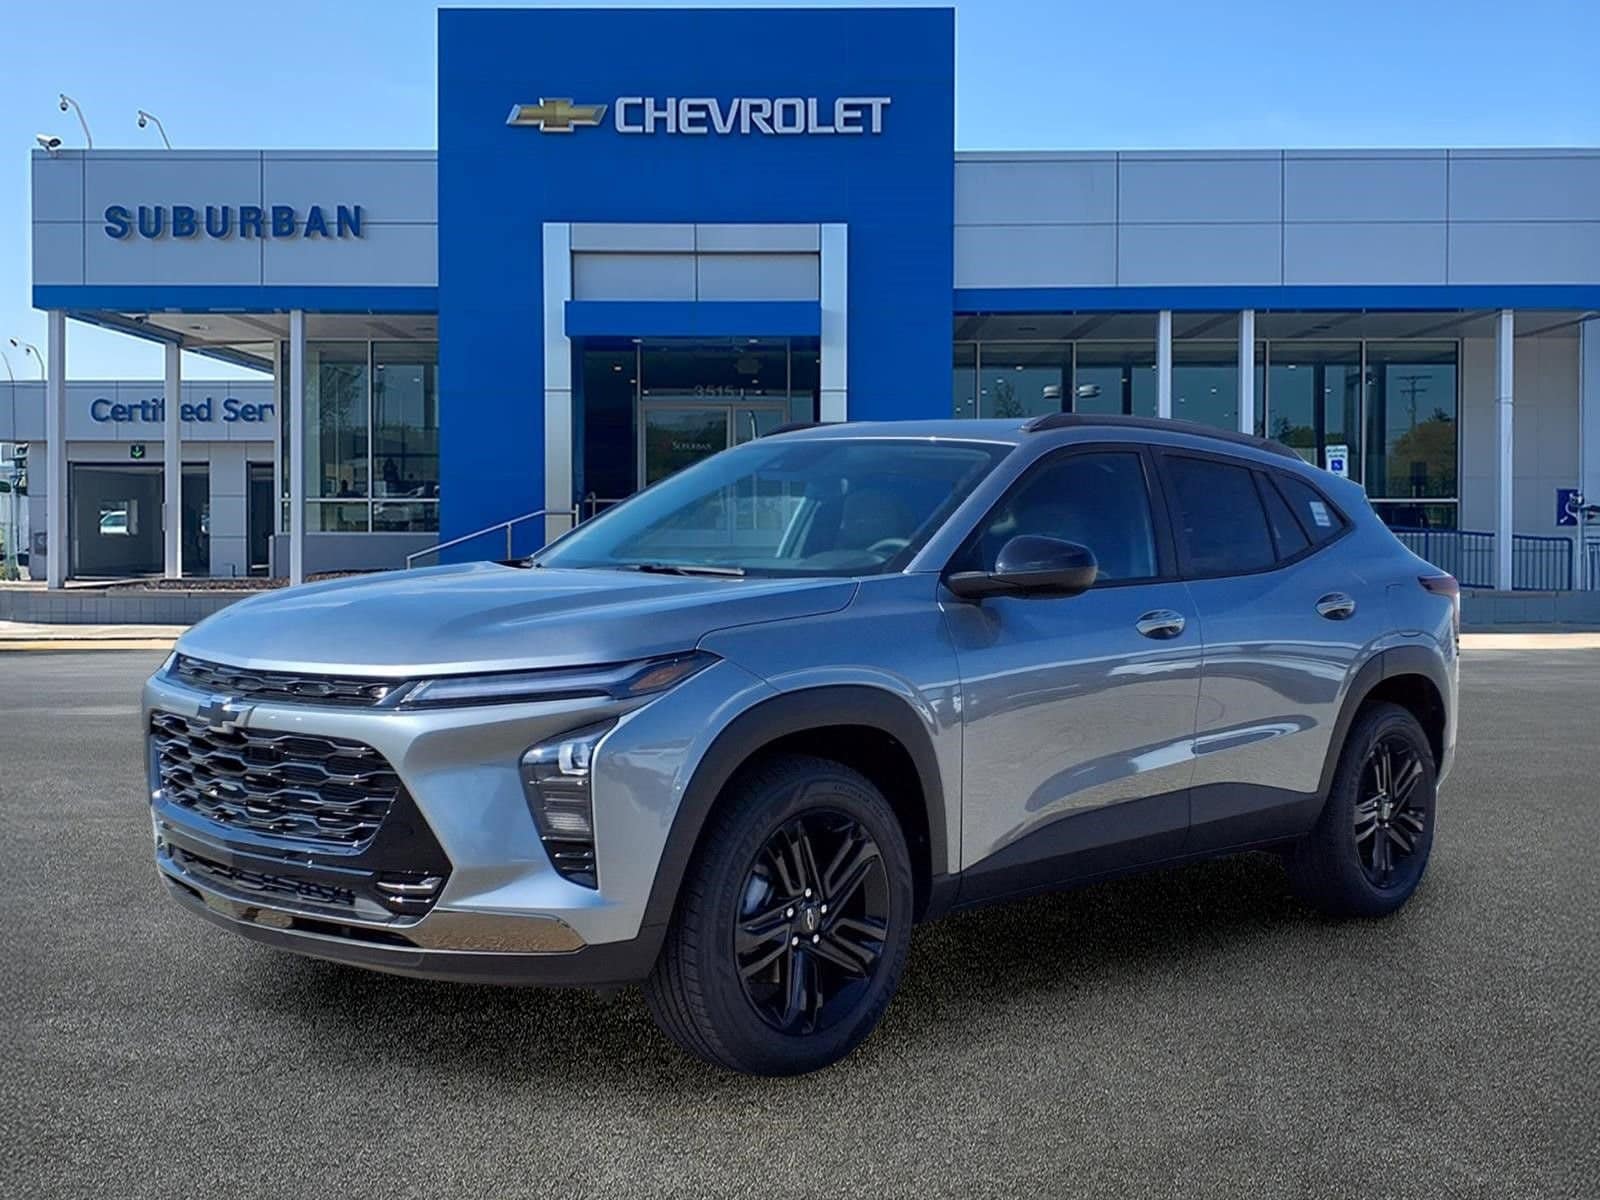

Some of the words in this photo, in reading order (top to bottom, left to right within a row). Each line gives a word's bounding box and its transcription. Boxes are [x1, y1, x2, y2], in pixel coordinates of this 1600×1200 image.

[615, 97, 891, 133] CHEVROLET
[104, 205, 362, 238] SUBURBAN
[91, 398, 212, 422] Certifed
